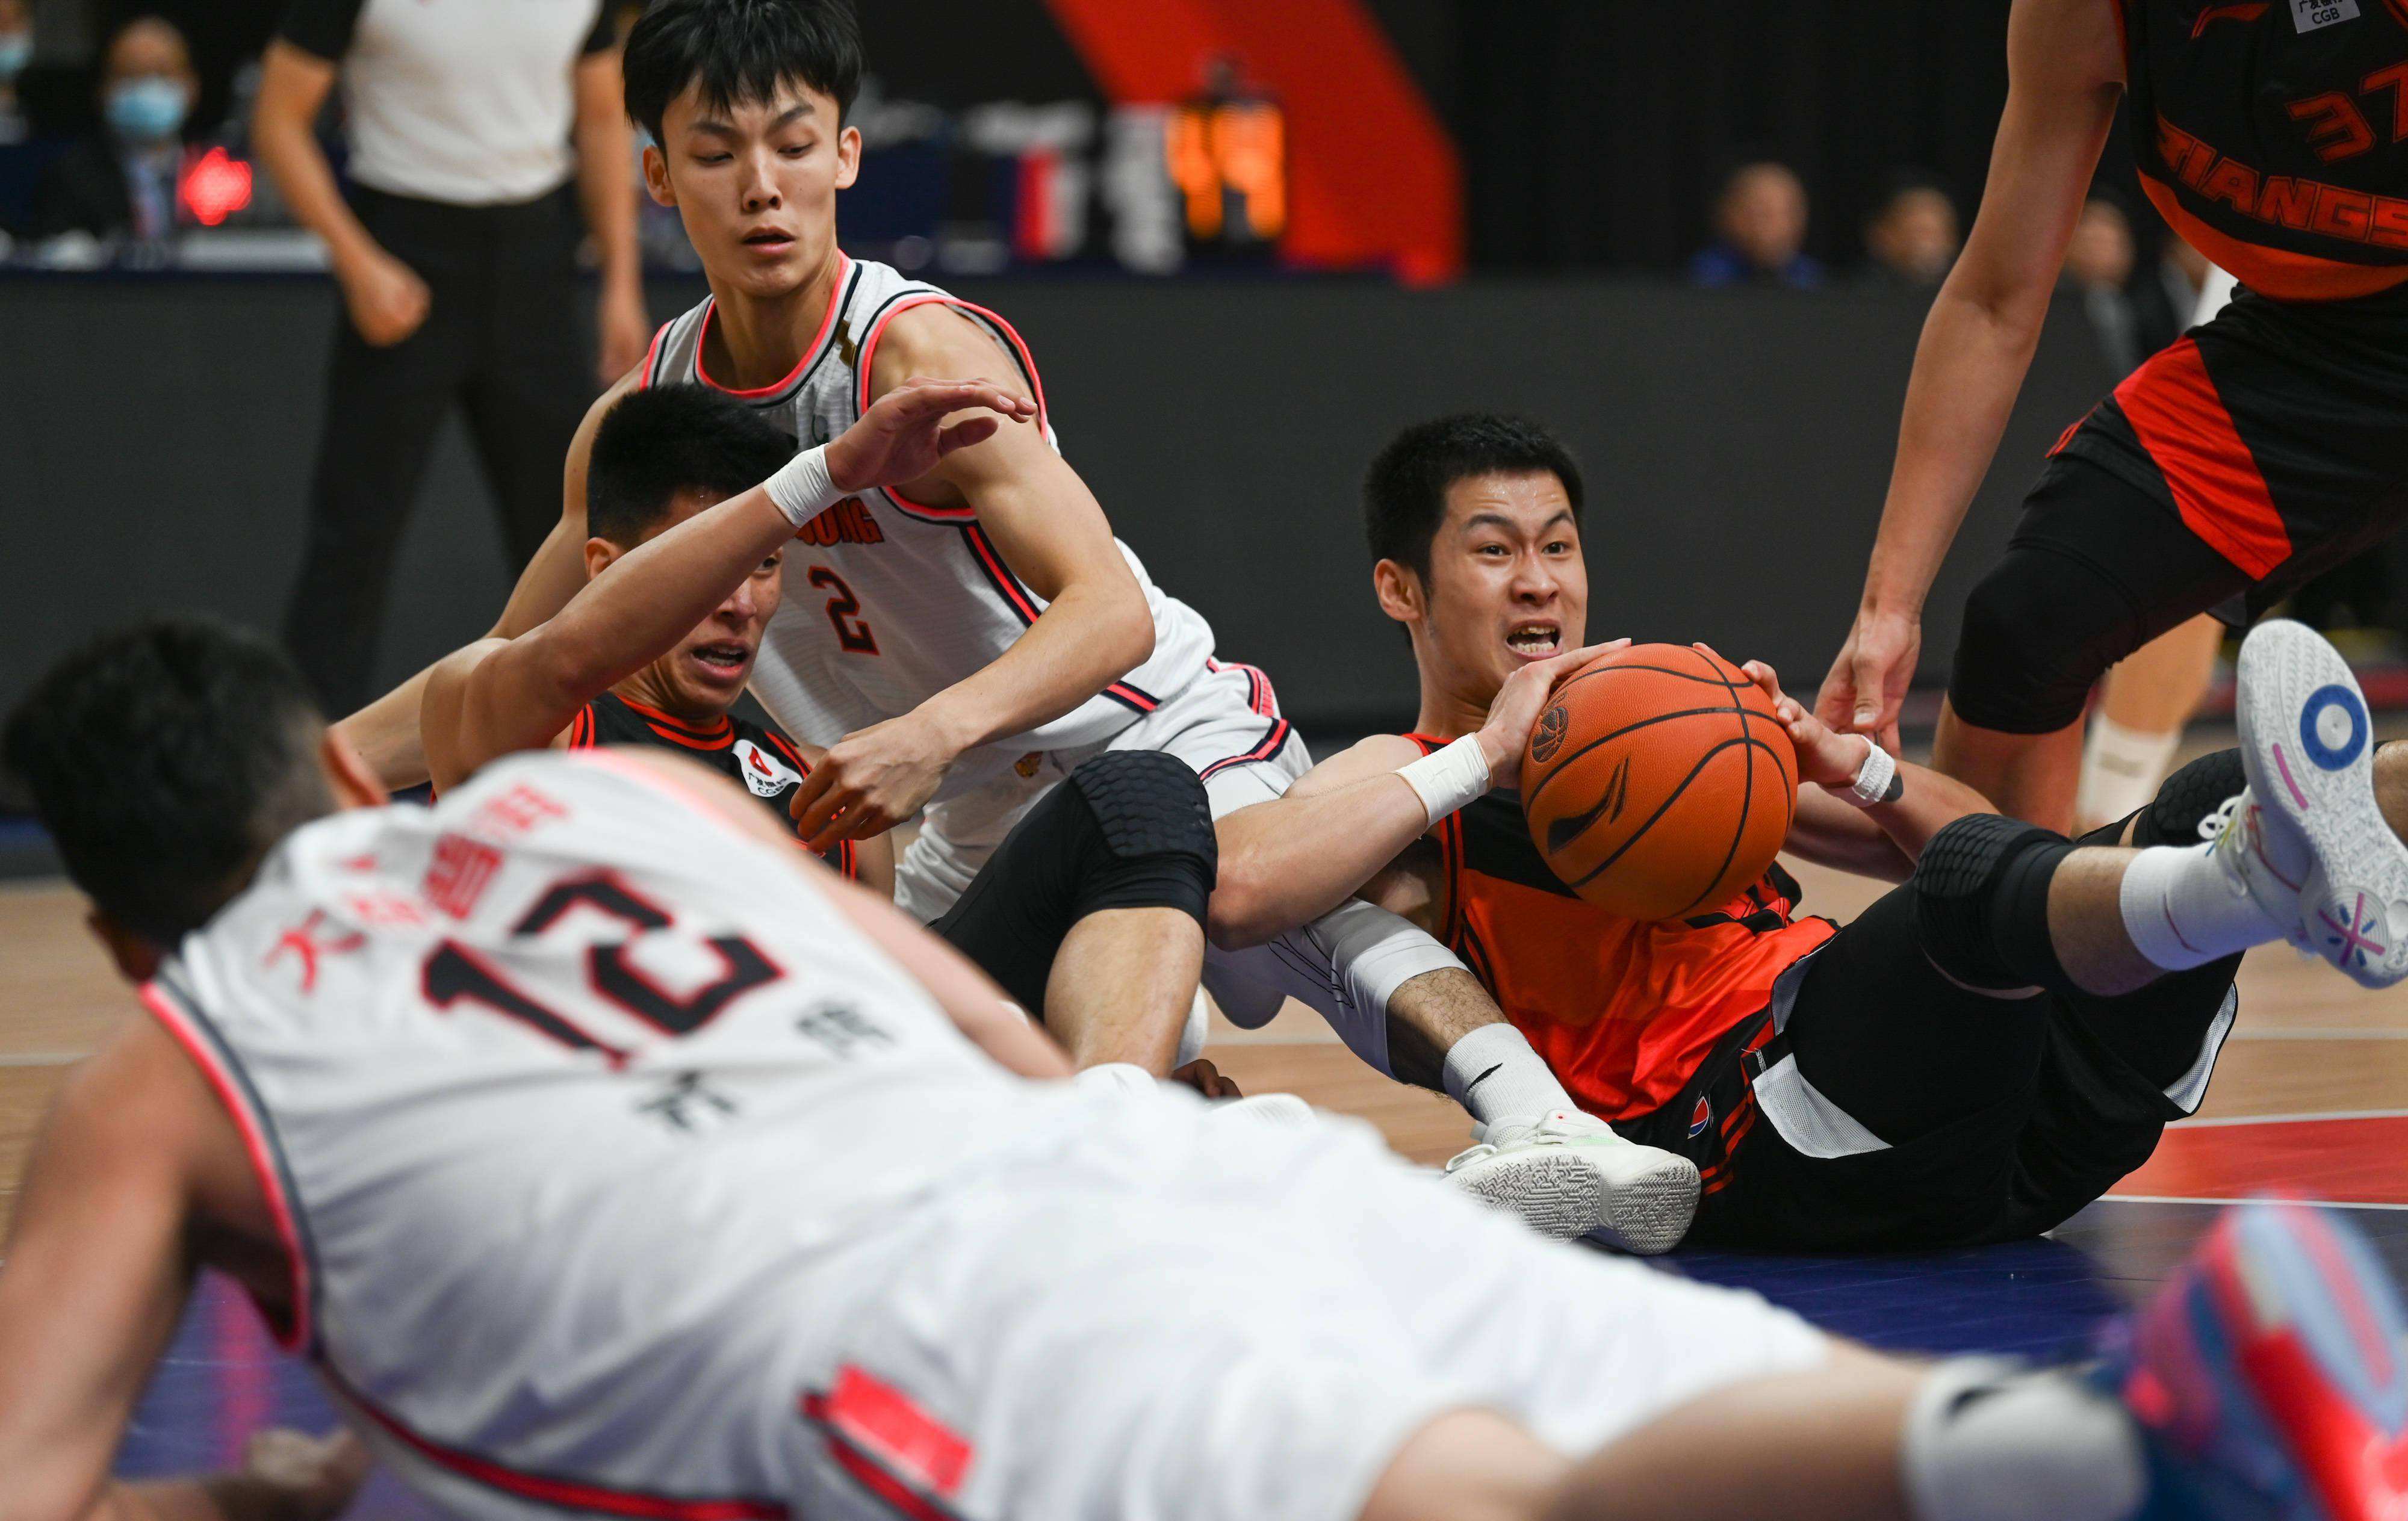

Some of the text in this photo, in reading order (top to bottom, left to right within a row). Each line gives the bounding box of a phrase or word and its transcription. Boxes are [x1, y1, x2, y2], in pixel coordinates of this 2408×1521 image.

[2312, 7, 2340, 24] CGB
[2286, 59, 2408, 166] 37
[807, 565, 880, 656] 2
[420, 867, 787, 1071] 12
